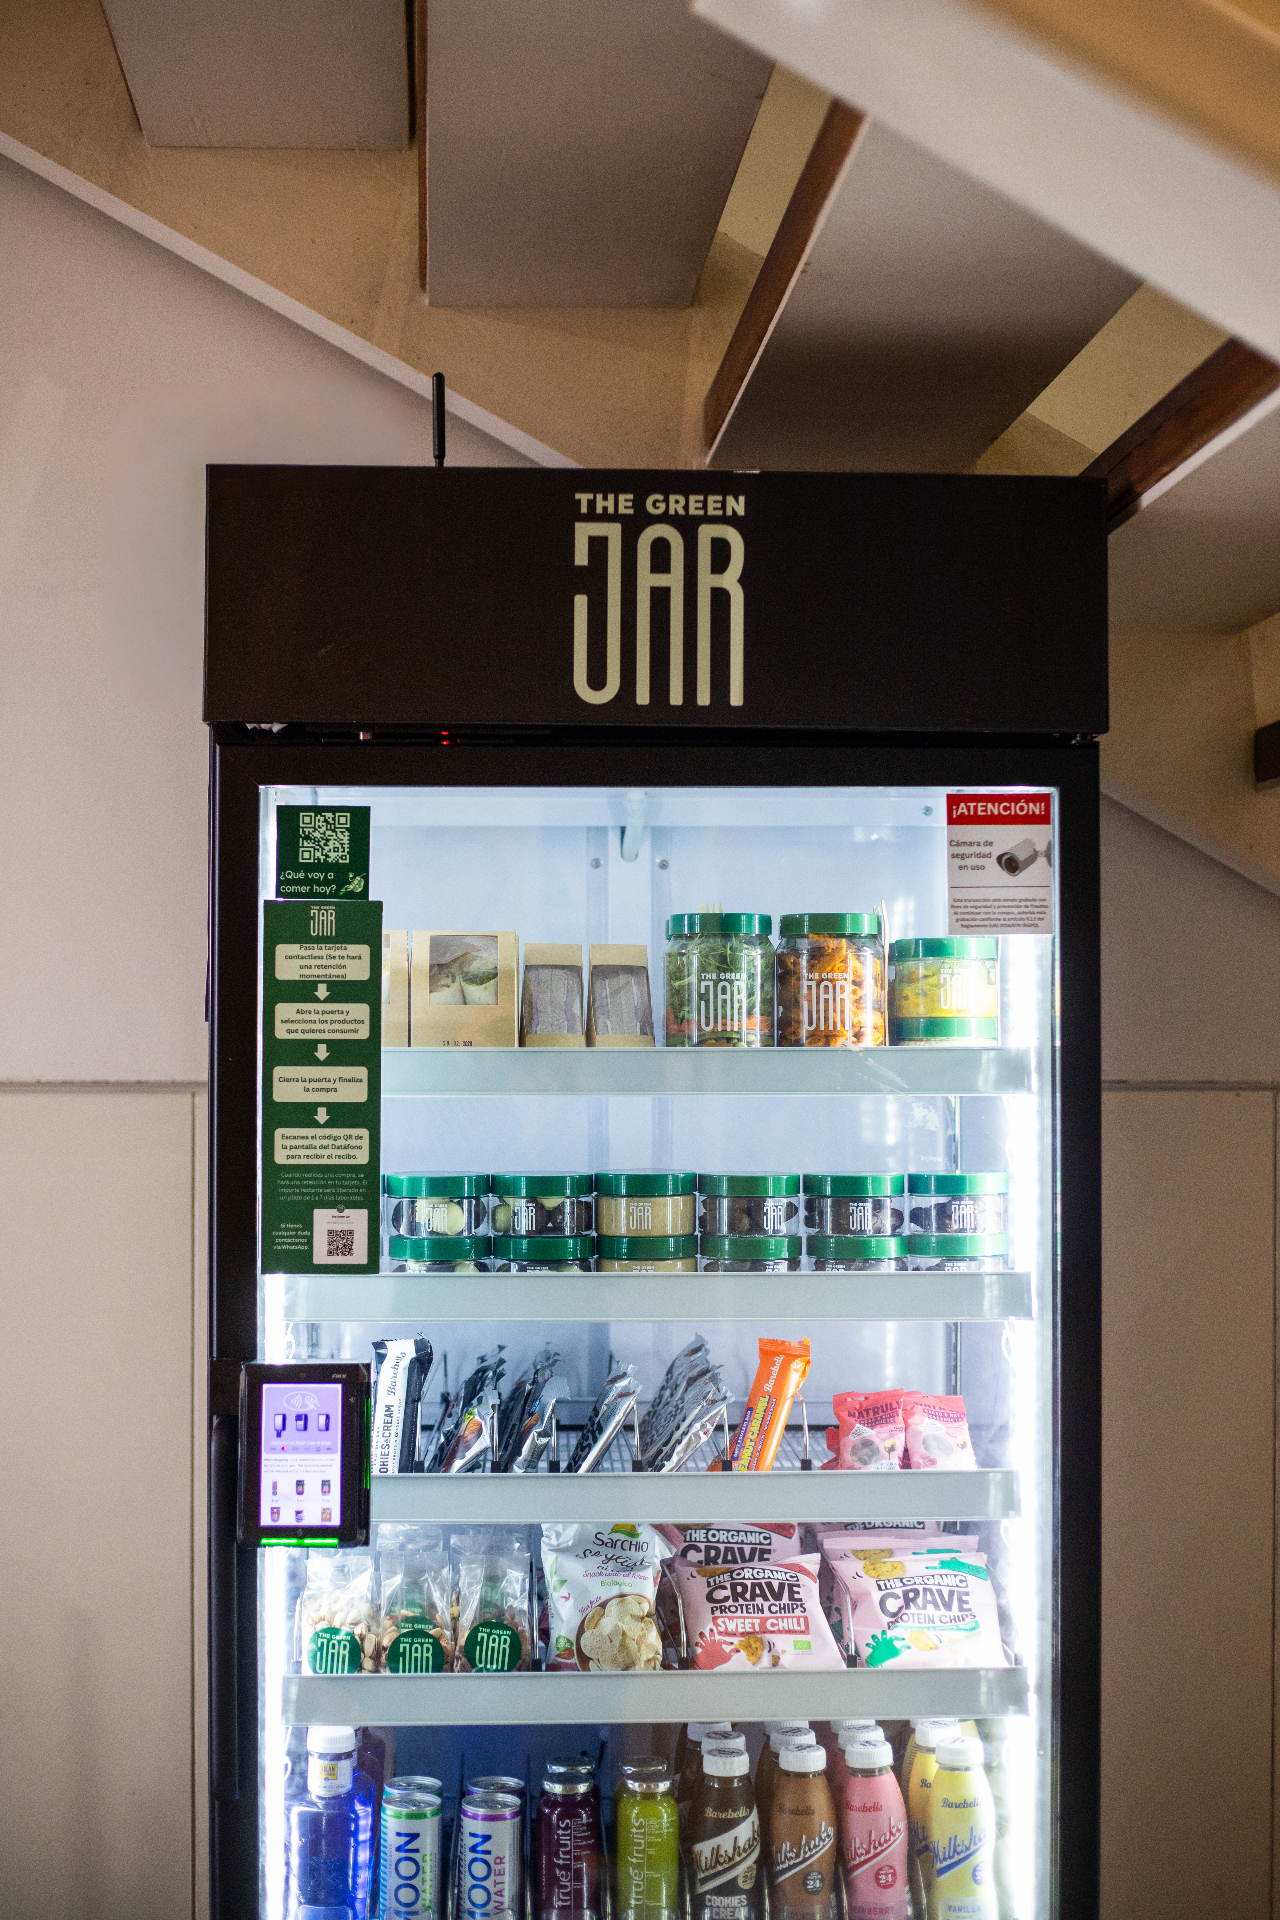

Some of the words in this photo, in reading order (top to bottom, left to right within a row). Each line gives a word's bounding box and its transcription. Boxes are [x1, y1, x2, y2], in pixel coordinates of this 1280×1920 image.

[575, 493, 634, 514] THE
[646, 494, 745, 516] GREEN
[574, 522, 745, 707] JAR
[952, 800, 1045, 818] ¡ATENCIÓN!
[951, 852, 992, 860] seguridad
[280, 870, 305, 879] ¿Qué
[308, 872, 325, 881] voy
[314, 884, 336, 895] hoy?
[311, 910, 335, 936] JAR
[701, 981, 747, 1032] JAR
[804, 981, 849, 1031] JAR
[426, 1207, 448, 1232] JAR
[515, 1207, 536, 1231] JAR
[630, 1207, 652, 1230] JAR
[764, 1207, 783, 1230] JAR
[850, 1207, 872, 1231] JAR
[952, 1205, 974, 1229] JAR
[764, 1355, 785, 1392] Barebells
[739, 1439, 755, 1471] EANUT
[748, 1395, 771, 1439] CARAMEL
[686, 1530, 706, 1542] THE
[707, 1530, 771, 1545] ORGANIC
[680, 1544, 772, 1566] CRAVE
[707, 1572, 732, 1587] THE
[732, 1568, 799, 1582] ORGANIC
[877, 1579, 903, 1590] THE
[903, 1574, 967, 1587] ORGANIC
[706, 1581, 803, 1604] CRAVE
[879, 1587, 973, 1618] CRAVE
[711, 1603, 764, 1615] PROTEIN
[768, 1603, 807, 1614] CHIPS
[939, 1612, 976, 1624] CHIPS
[717, 1617, 760, 1632] SWEET
[766, 1617, 805, 1631] CHILI
[316, 1638, 349, 1674] JAR
[400, 1644, 433, 1674] JAR
[476, 1633, 511, 1671] JAR
[705, 1807, 750, 1819] Barebells
[554, 1819, 571, 1865] fruits
[628, 1817, 645, 1864] fruits
[421, 1852, 433, 1913] WATER
[494, 1855, 506, 1916] WATER
[556, 1867, 571, 1909] true
[630, 1867, 643, 1906] true
[706, 1895, 747, 1907] COOKIES
